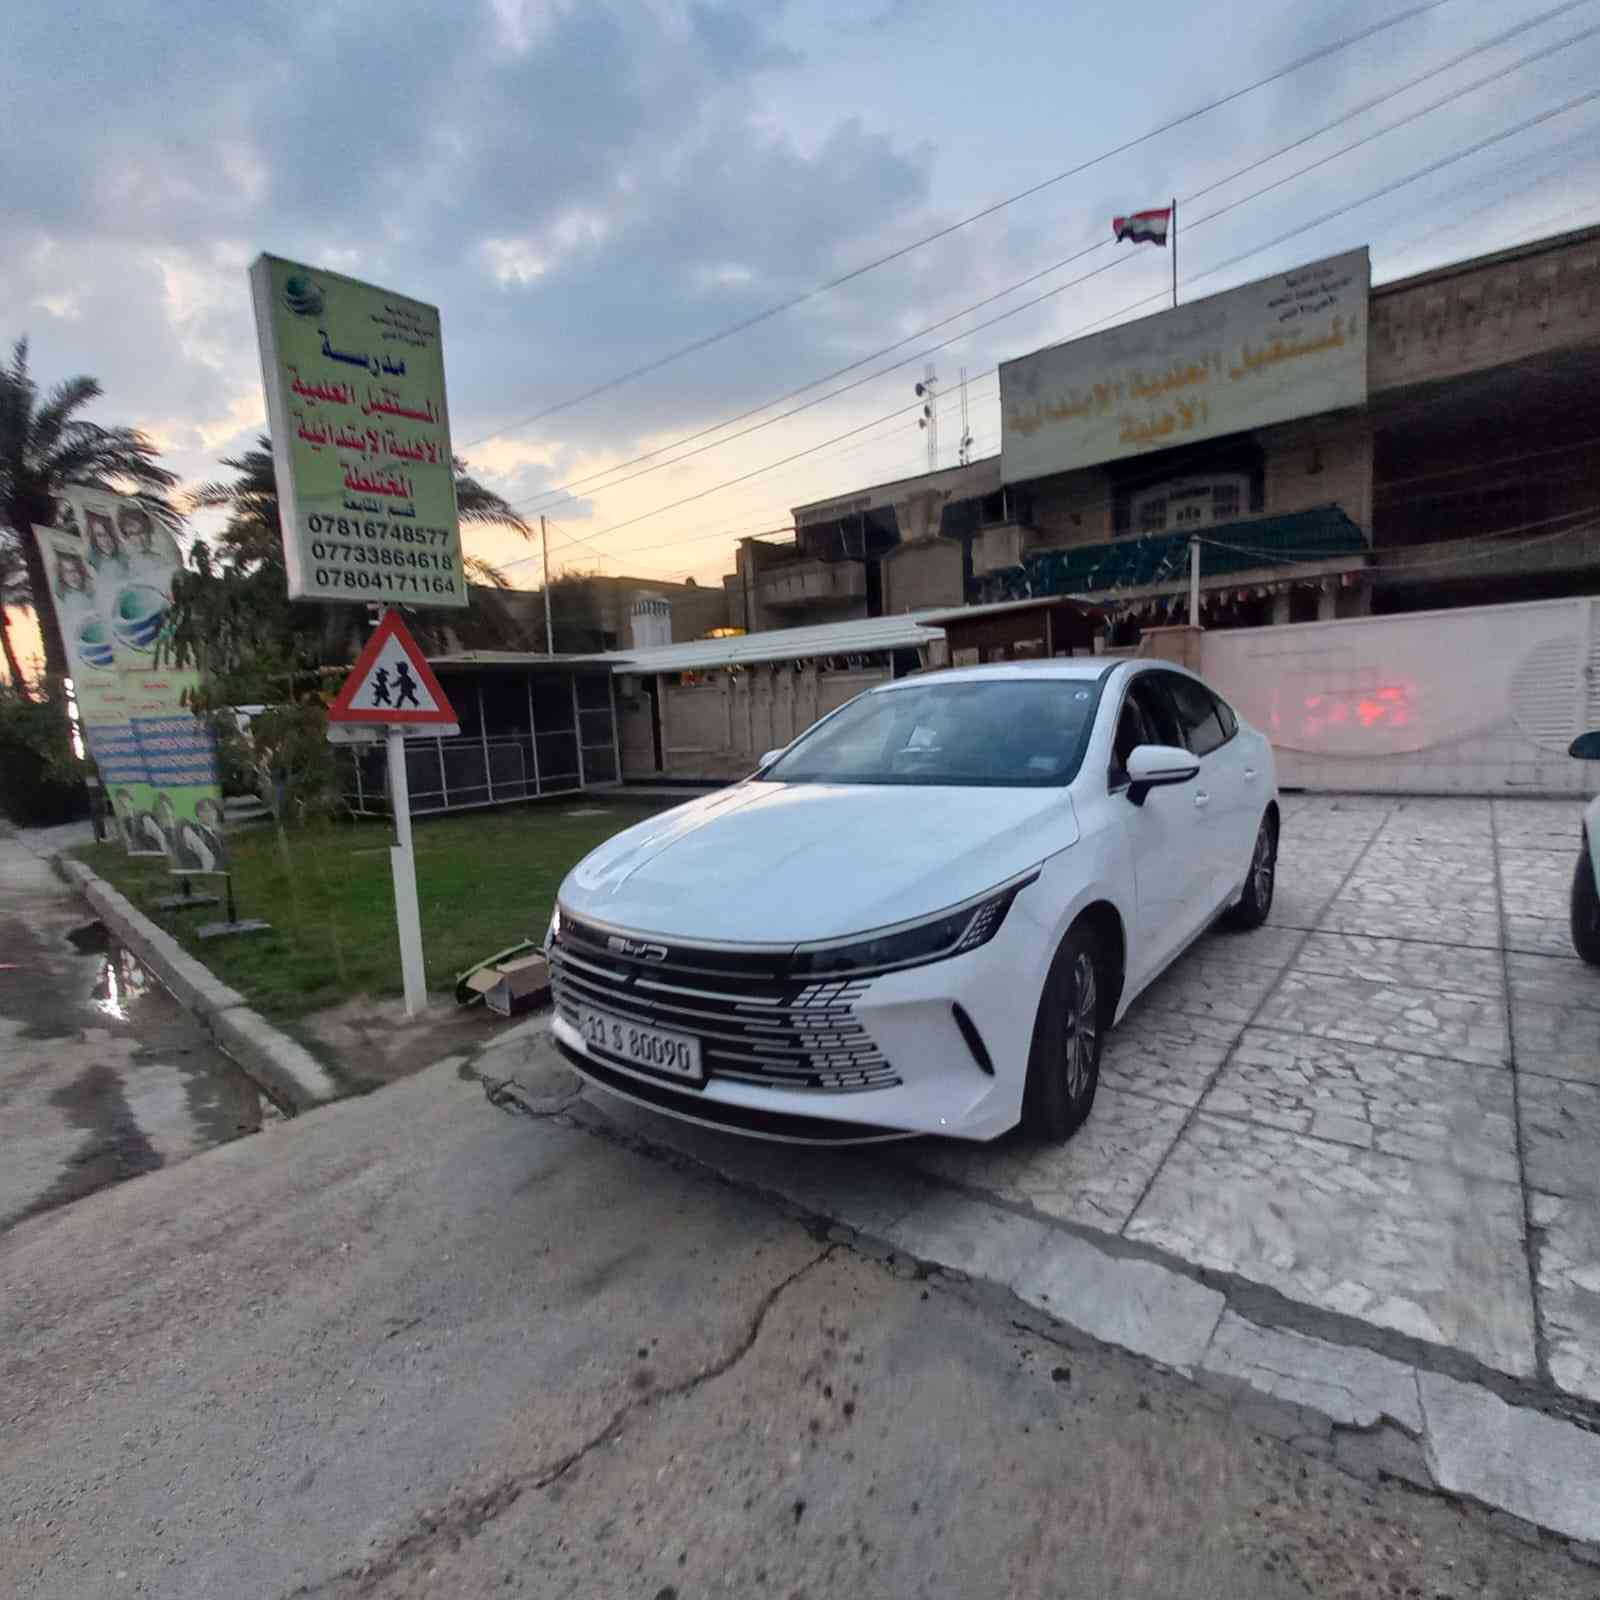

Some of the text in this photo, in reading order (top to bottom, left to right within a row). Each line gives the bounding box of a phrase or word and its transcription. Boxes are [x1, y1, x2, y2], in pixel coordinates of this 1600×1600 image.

[318, 328, 406, 377] مدرسة
[290, 367, 440, 424] المستقبل العلمية
[339, 459, 415, 499] المختلطة
[308, 514, 449, 546] 07816748577
[311, 541, 453, 571] 07733864618
[315, 567, 456, 595] 07804171164
[608, 935, 668, 961] BYD
